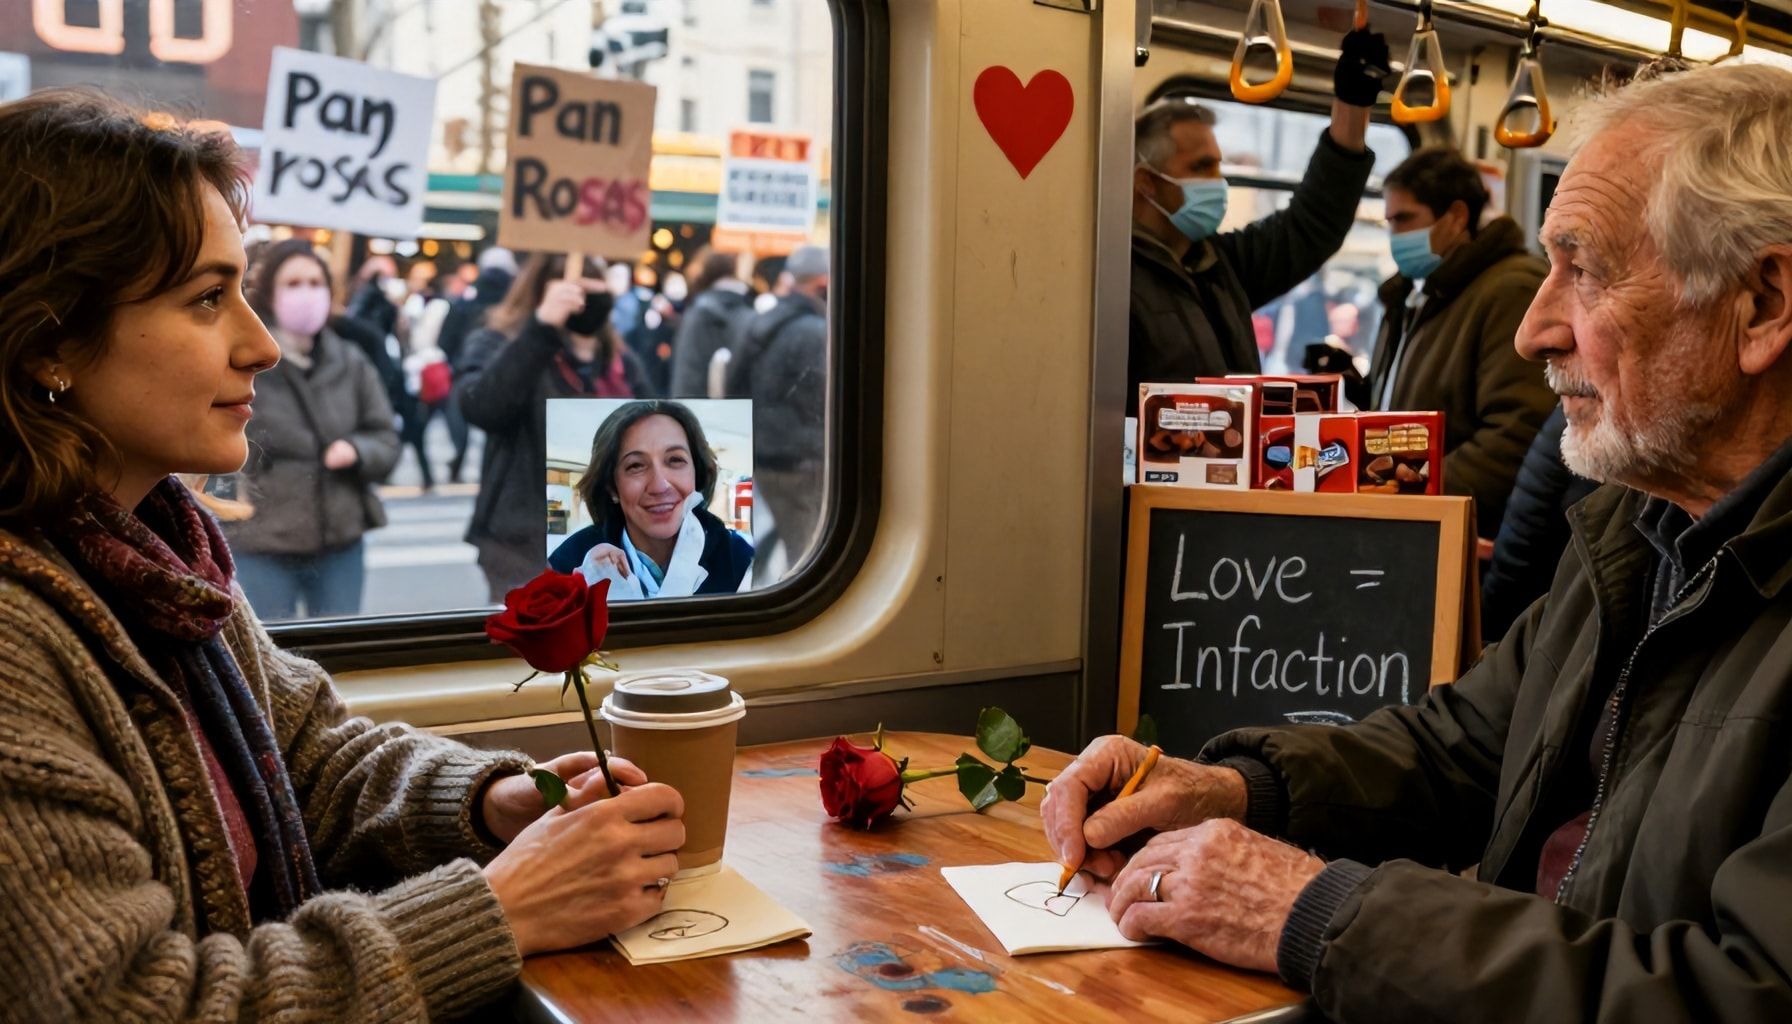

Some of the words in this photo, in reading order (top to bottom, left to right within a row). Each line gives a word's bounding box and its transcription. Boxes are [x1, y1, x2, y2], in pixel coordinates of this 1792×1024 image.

[519, 75, 622, 145] Pan
[1170, 533, 1313, 603] Love
[1161, 614, 1410, 706] Infaction
